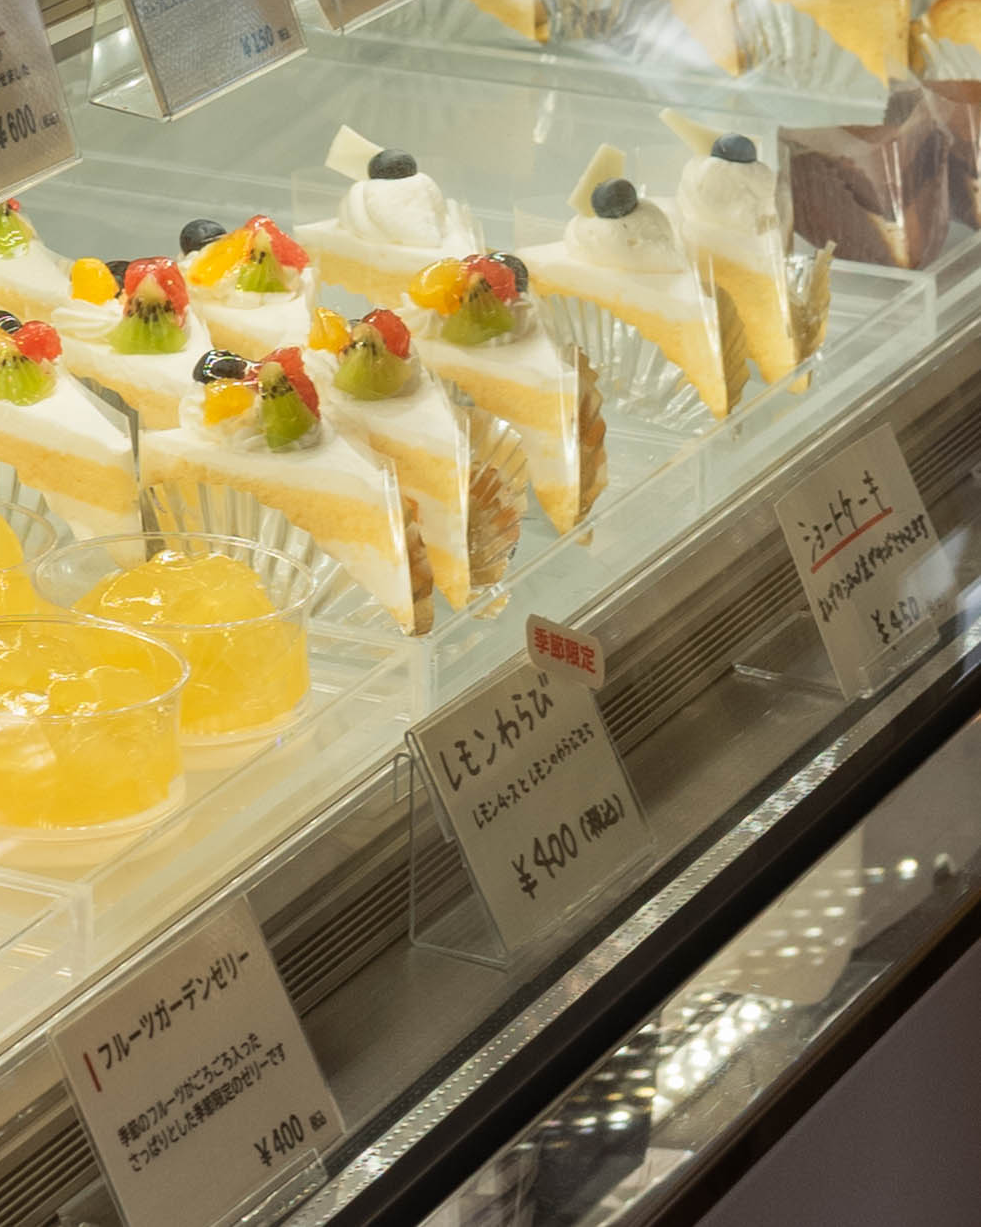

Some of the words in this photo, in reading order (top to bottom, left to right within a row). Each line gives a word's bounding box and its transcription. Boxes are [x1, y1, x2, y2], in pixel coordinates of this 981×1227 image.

[533, 627, 597, 674] 季節限定
[511, 822, 579, 901] ¥400
[96, 951, 250, 1070] フルーツガーデンゼリー
[117, 1032, 263, 1147] 季節のフルーツがごろごろ入った
[127, 1042, 286, 1173] さっぱりとした季節限定のゼリーです
[253, 1113, 306, 1168] ¥400
